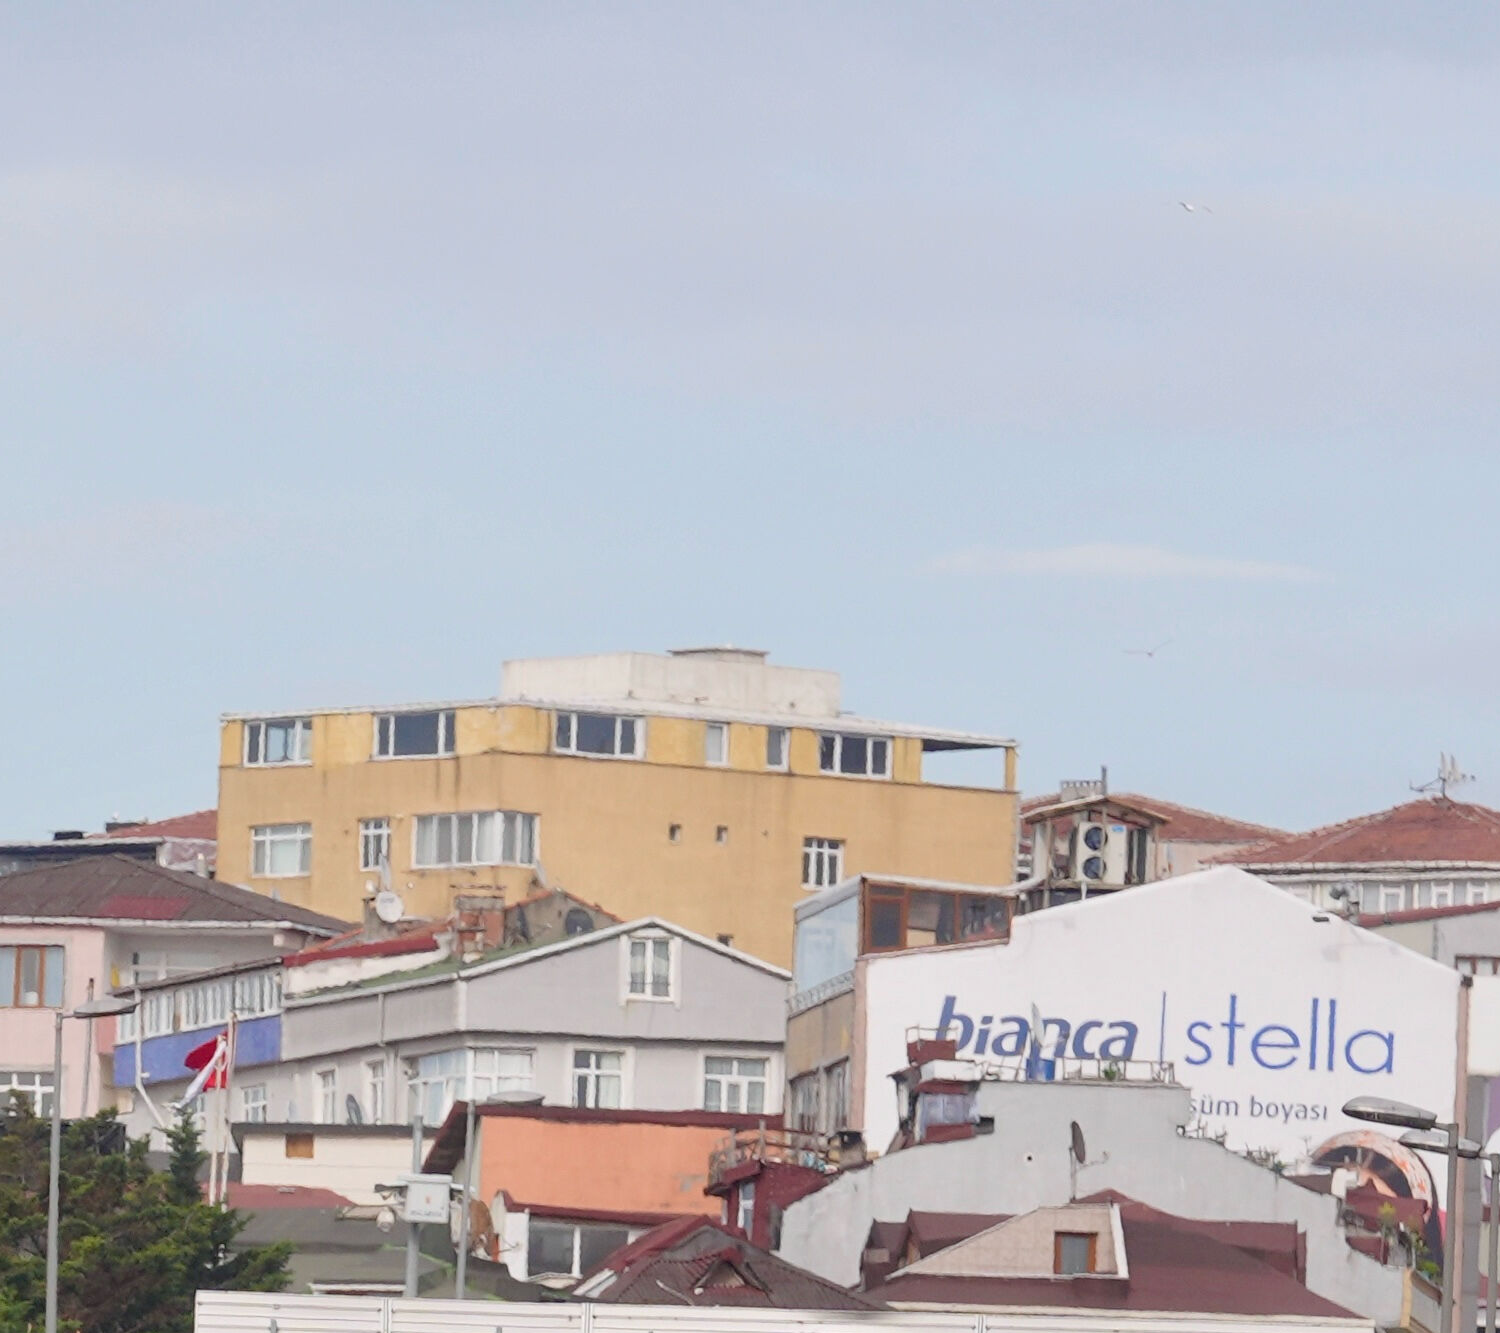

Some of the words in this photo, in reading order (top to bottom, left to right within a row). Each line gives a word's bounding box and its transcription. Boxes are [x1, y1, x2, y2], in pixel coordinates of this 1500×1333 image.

[936, 995, 1139, 1063] bianca
[1185, 994, 1396, 1075] stella
[1249, 1094, 1329, 1123] boyası
